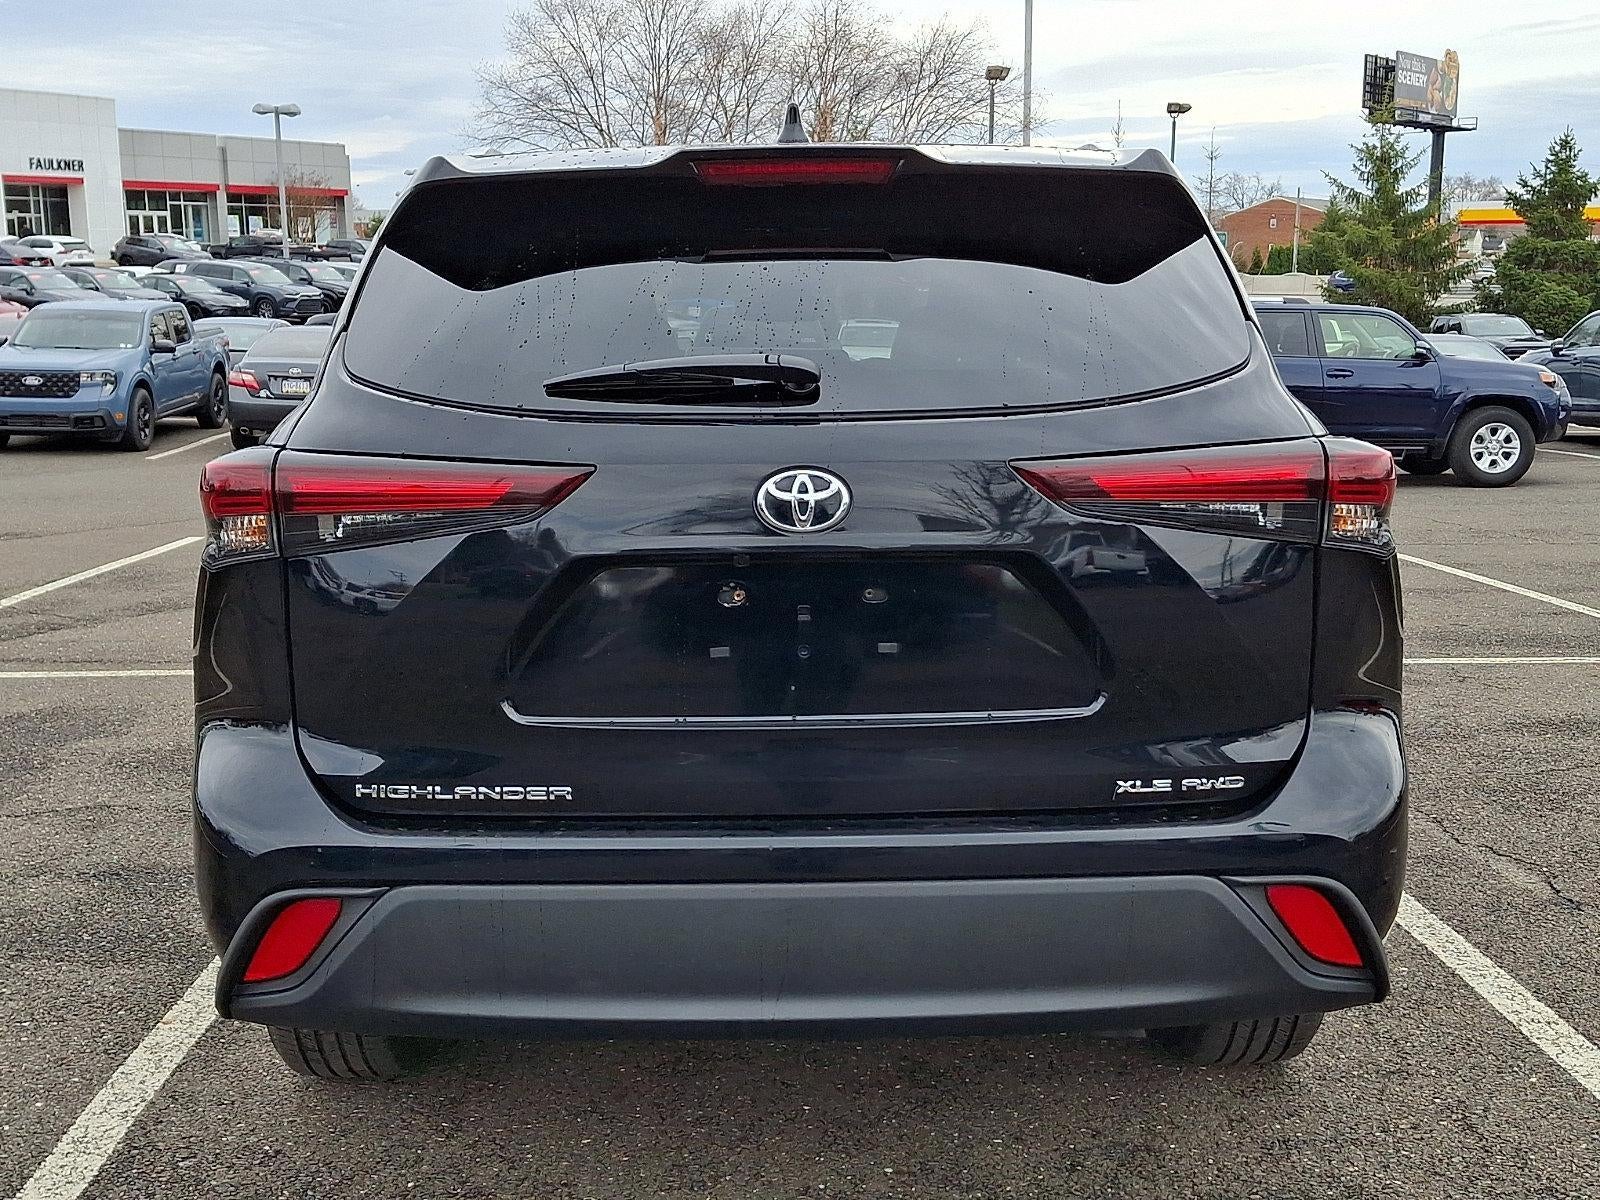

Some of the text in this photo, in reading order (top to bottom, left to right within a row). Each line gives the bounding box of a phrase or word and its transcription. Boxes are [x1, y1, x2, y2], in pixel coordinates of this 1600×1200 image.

[1397, 70, 1427, 87] SCENERY
[29, 157, 84, 172] FAULKNER
[355, 784, 573, 801] HIGHLANDER
[1116, 776, 1245, 793] XLE AWD
